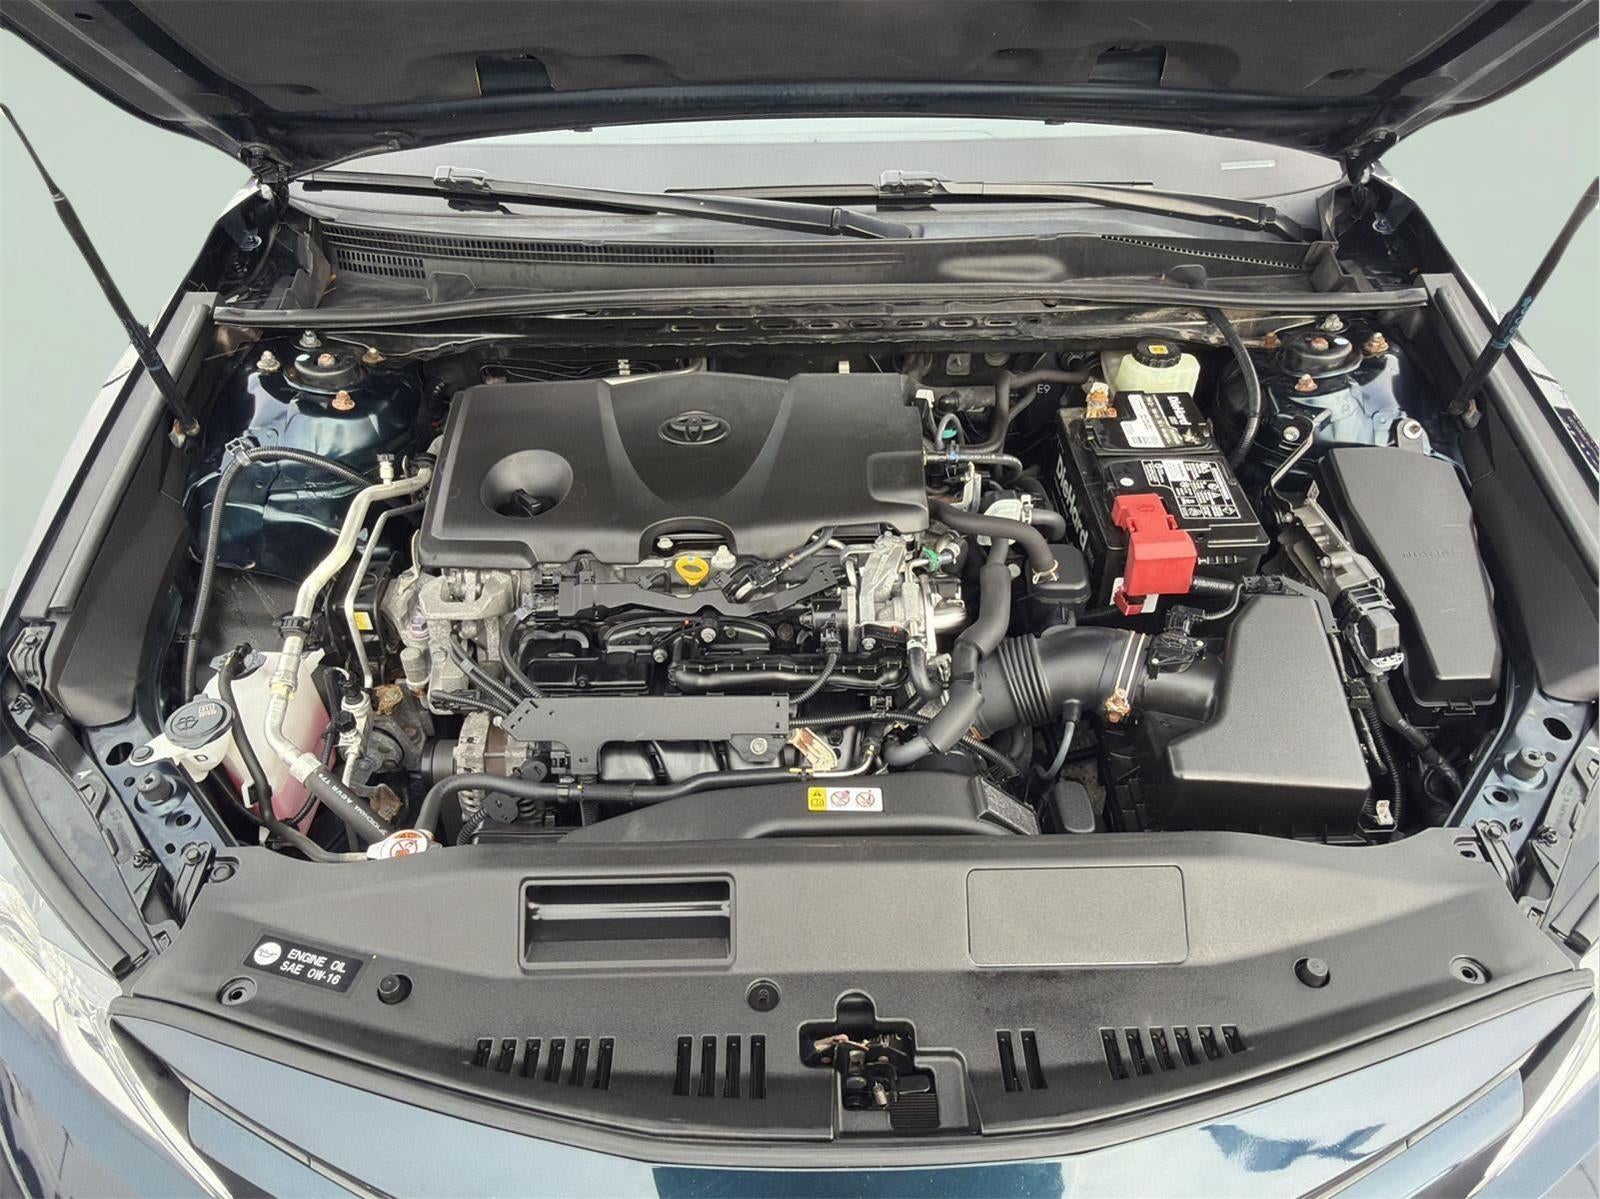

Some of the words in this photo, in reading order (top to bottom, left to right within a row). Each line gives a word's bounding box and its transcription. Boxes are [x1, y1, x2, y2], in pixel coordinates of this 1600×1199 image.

[1036, 383, 1051, 394] E9
[1056, 453, 1089, 552] DieHard
[280, 960, 305, 975] SAE
[307, 968, 342, 986] 0W-16
[287, 948, 328, 967] ENGINE
[330, 960, 346, 974] OIL
